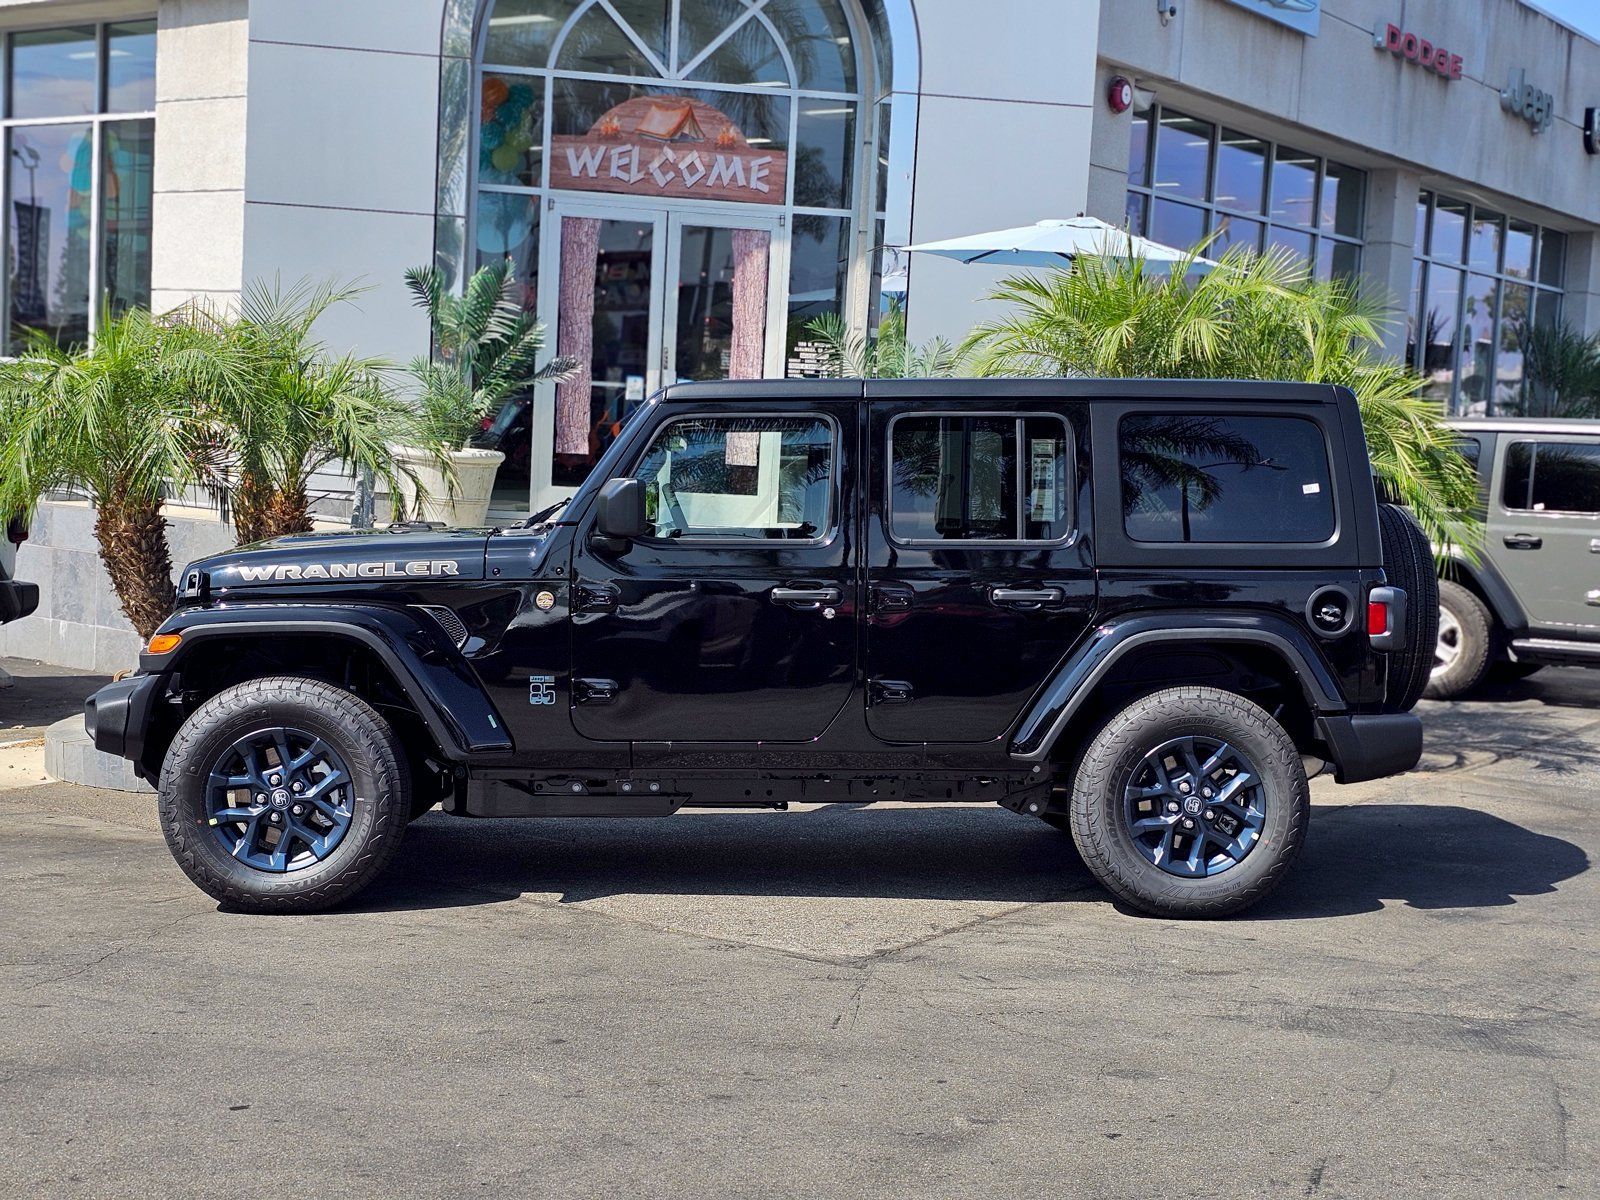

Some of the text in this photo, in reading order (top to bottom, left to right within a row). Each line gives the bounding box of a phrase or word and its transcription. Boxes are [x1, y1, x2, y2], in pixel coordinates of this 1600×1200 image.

[1386, 23, 1463, 80] DODGE
[1502, 67, 1553, 134] Jeep
[565, 143, 773, 193] WELCOME
[239, 560, 459, 581] WRANGLER
[530, 683, 556, 705] 85
